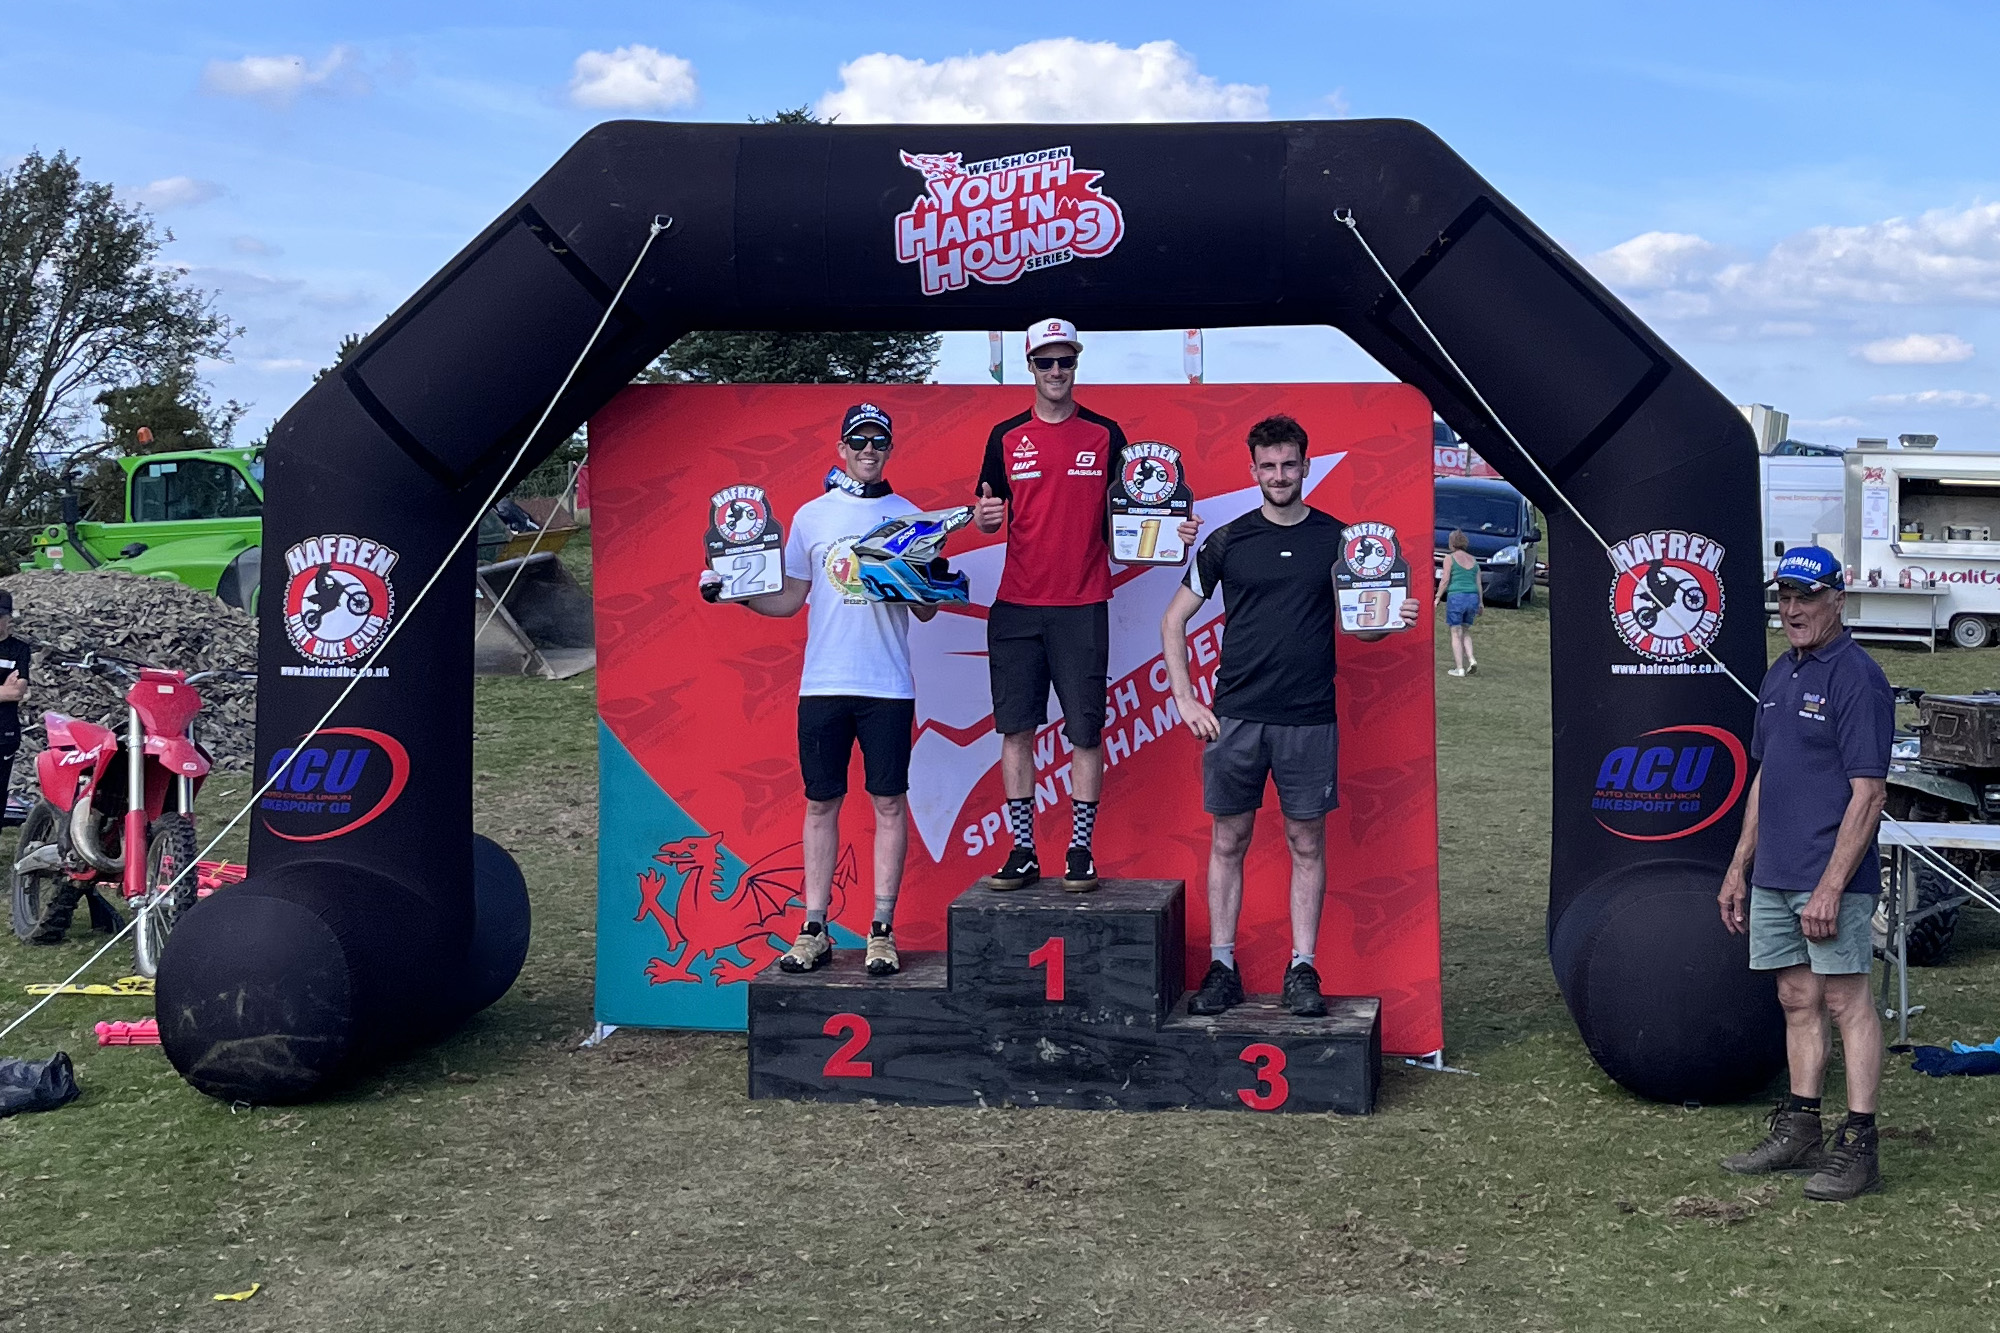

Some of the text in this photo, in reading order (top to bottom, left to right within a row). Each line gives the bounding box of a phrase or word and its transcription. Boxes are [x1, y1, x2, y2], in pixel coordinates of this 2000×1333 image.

[968, 147, 1069, 175] WELSH OPEN
[930, 159, 1068, 214] YOUTH
[900, 191, 1055, 258] HARE 'N
[925, 201, 1112, 292] HOUNDS
[1026, 249, 1071, 270] SERIES
[1122, 443, 1179, 464] HAFREN
[711, 485, 765, 508] HAFREN
[829, 470, 865, 496] 100%
[1136, 519, 1161, 559] 1
[1340, 522, 1396, 542] HAFREN
[1613, 532, 1723, 573] HAFREN
[286, 536, 396, 577] HAFREN
[731, 553, 767, 596] 2
[1786, 556, 1823, 573] YAMAHA
[1355, 589, 1392, 628] 3
[288, 612, 385, 658] DIRT BIKE CLUB
[1617, 609, 1719, 656] DIRT BIKE CLUB
[266, 747, 371, 794] ACU
[1595, 745, 1716, 792] ACU
[328, 802, 352, 814] GB
[1591, 797, 1701, 813] BIKESPORT GB
[1594, 789, 1701, 800] AUTO CYCLE UNION
[1027, 936, 1066, 1001] 1
[822, 1012, 874, 1078] 2
[1236, 1043, 1289, 1111] 3
